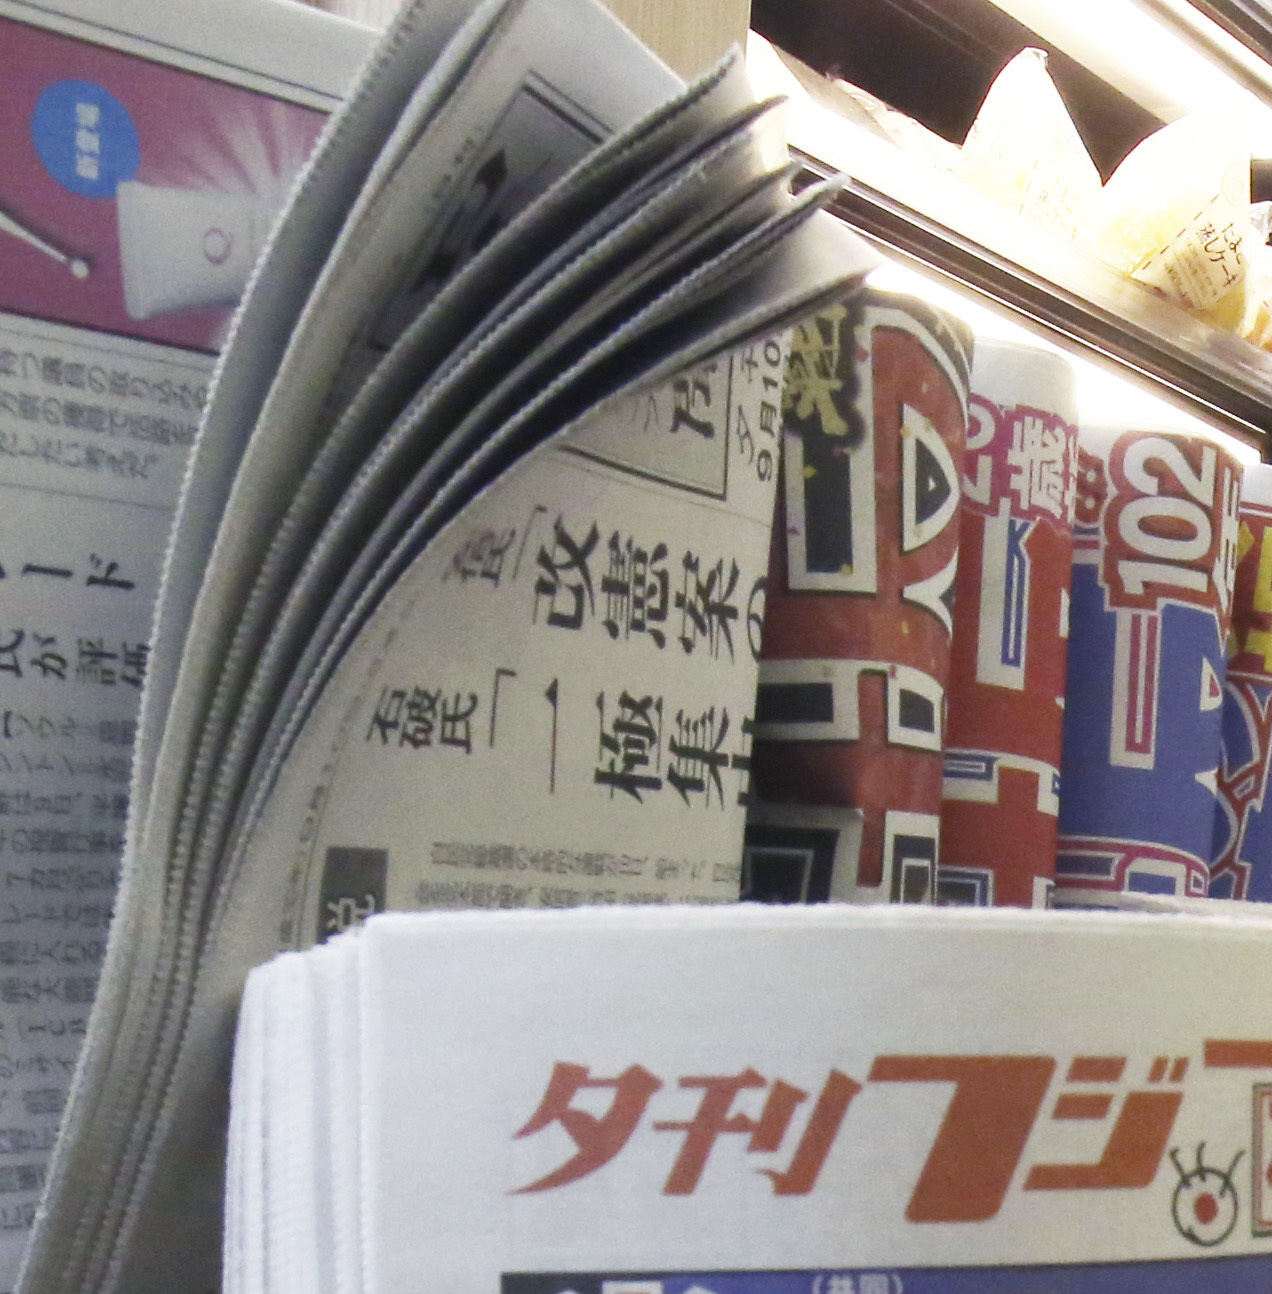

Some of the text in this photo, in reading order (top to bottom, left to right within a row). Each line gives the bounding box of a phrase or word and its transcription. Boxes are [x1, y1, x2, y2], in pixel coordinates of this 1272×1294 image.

[0, 551, 137, 592] ード
[505, 1053, 1191, 1223] 夕刊フジ
